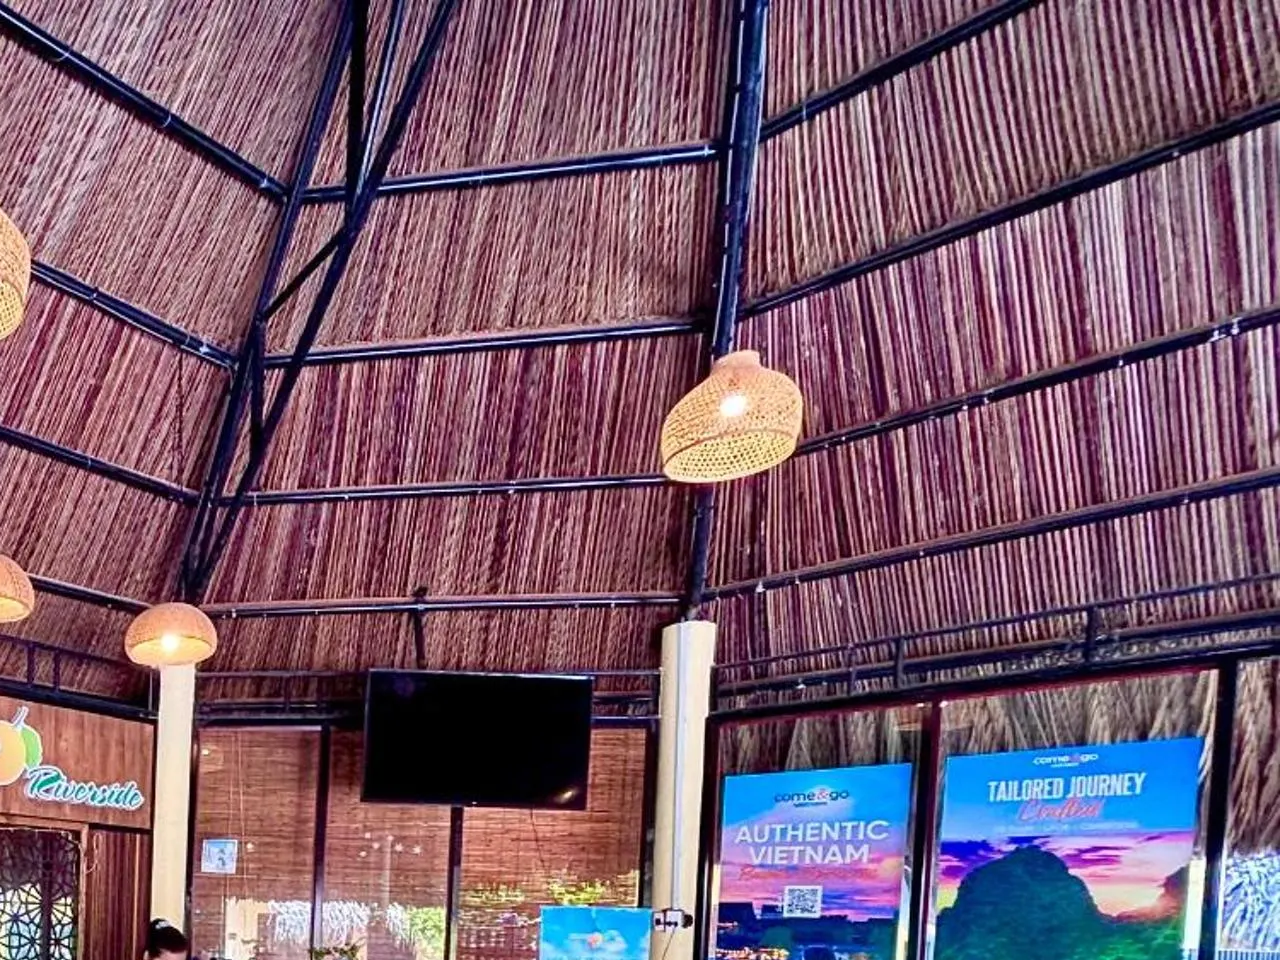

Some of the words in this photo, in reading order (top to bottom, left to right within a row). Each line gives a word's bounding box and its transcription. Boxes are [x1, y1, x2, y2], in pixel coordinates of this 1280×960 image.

[23, 765, 144, 811] Riverside
[774, 788, 850, 803] come&go
[987, 777, 1064, 802] TAILORED
[1066, 772, 1147, 798] JOURNEY
[735, 820, 890, 844] AUTHENTIC
[750, 844, 869, 865] VIETNAM
